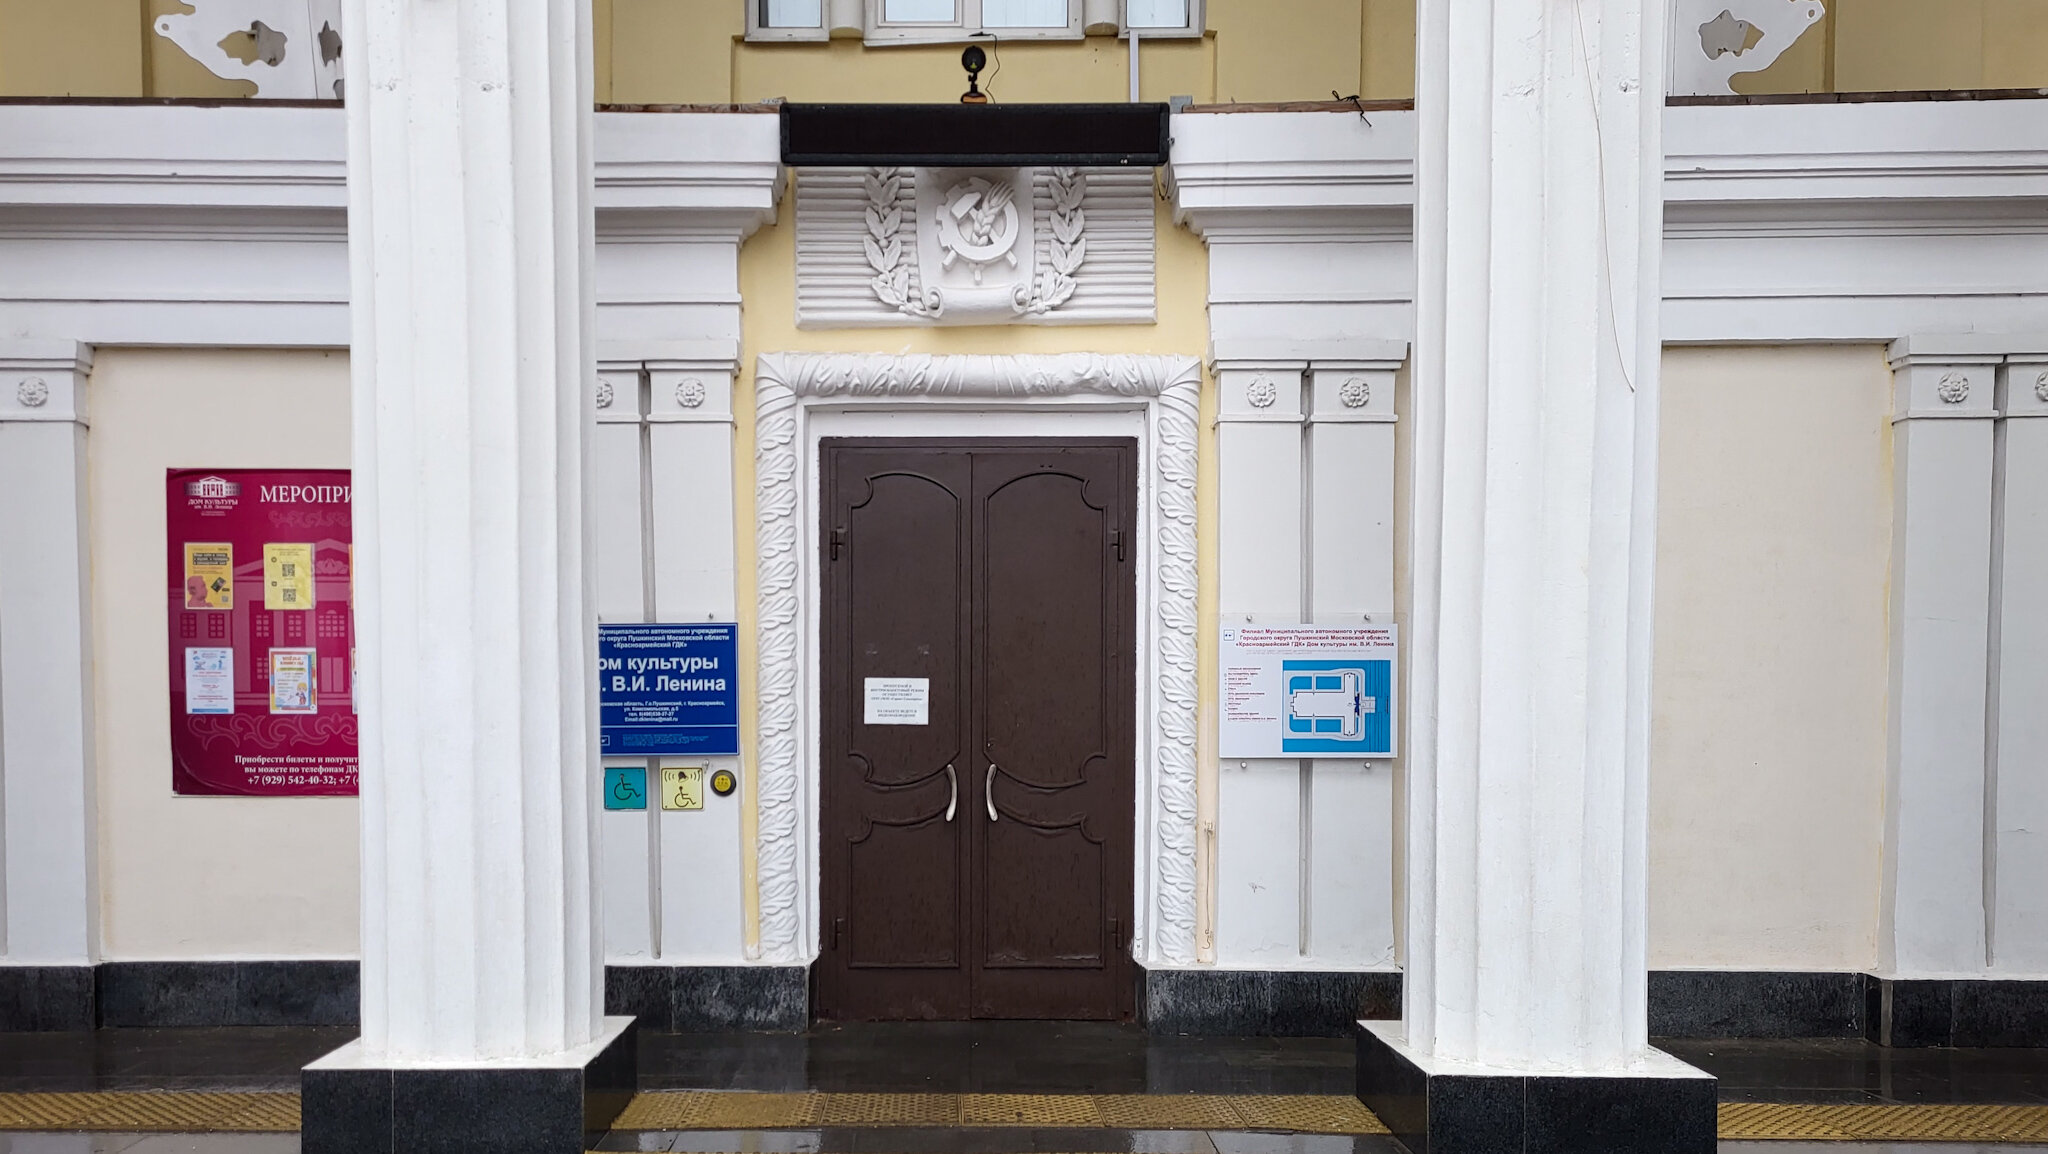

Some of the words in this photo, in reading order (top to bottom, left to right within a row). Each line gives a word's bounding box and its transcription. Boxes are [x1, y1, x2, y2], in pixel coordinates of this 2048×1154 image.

[627, 657, 718, 674] культуры
[612, 676, 650, 692] В.И.
[655, 675, 726, 692] Ленина
[235, 755, 284, 765] Приобрести
[286, 755, 316, 763] билеты
[301, 765, 344, 775] телефонам
[247, 776, 260, 785] +7
[262, 775, 286, 786] (929)
[288, 775, 337, 785] 542-40-32;
[338, 776, 351, 785] +7
